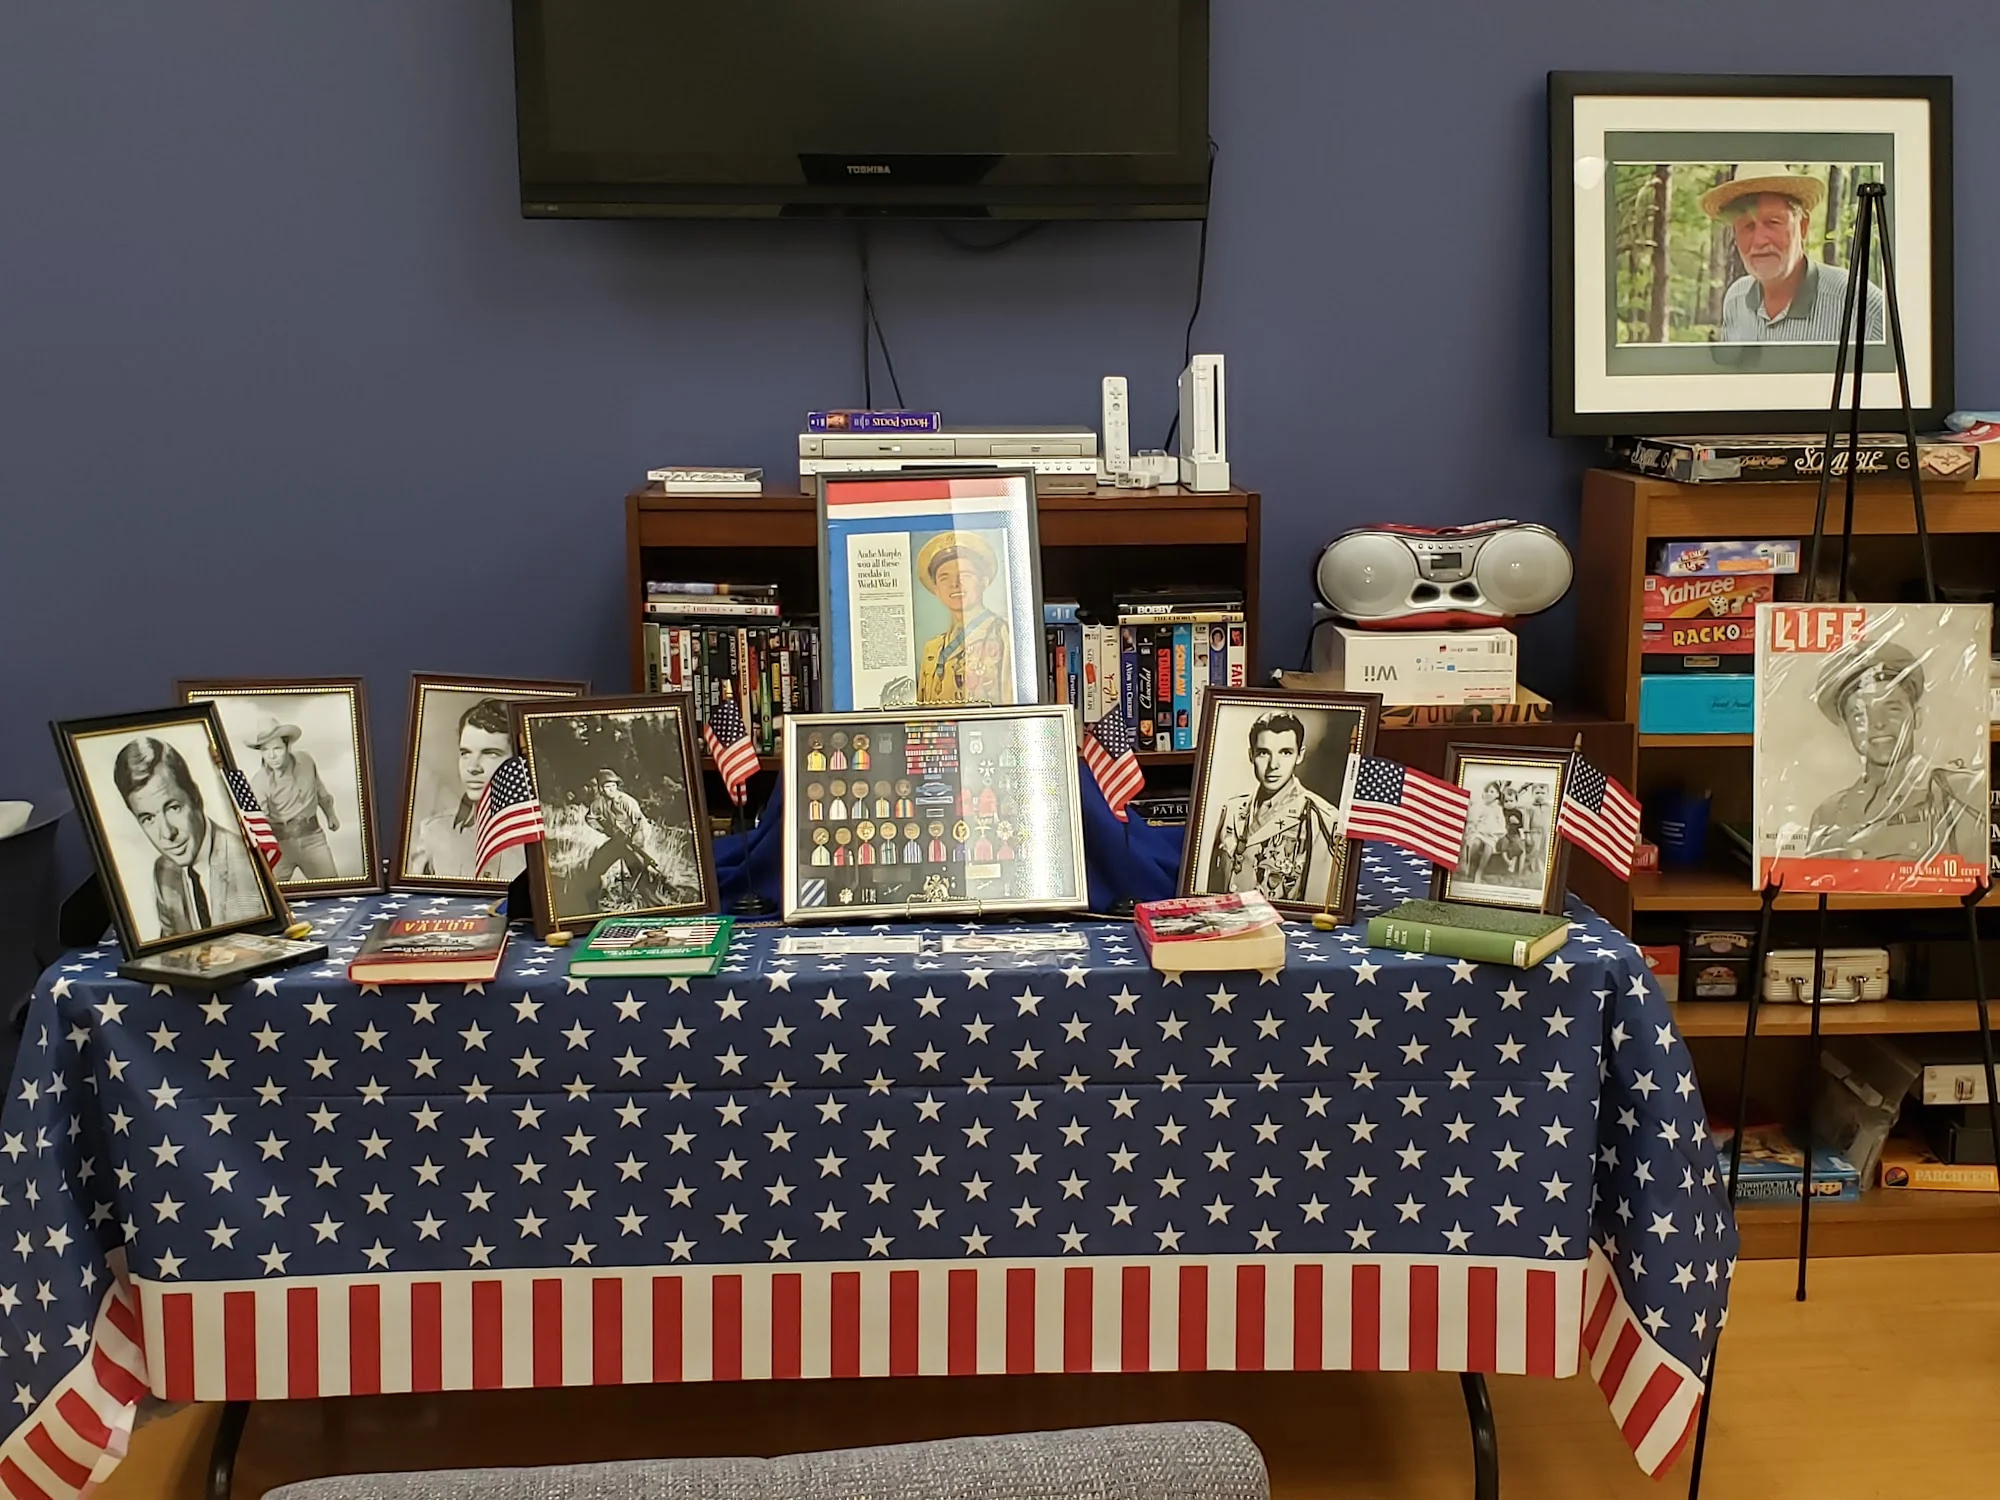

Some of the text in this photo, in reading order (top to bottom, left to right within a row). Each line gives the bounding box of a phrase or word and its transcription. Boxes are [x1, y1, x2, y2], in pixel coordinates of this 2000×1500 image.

[846, 165, 891, 174] TOSHIBA
[857, 549, 902, 560] Audie Murphy
[857, 558, 899, 568] won all these
[857, 568, 890, 578] medals in
[858, 579, 878, 589] World
[878, 578, 893, 588] War
[1660, 577, 1735, 606] Yahtzee
[1137, 605, 1173, 614] BOBBY
[1775, 611, 1866, 649] LIFE
[1158, 648, 1171, 702] STAKEOUT
[1363, 665, 1397, 682] Wii
[1069, 675, 1078, 705] Brother
[1139, 667, 1152, 709] Chocolat
[1943, 859, 1957, 877] 10
[404, 920, 475, 931] VALOR
[1915, 1169, 1995, 1183] PARCHEESI
